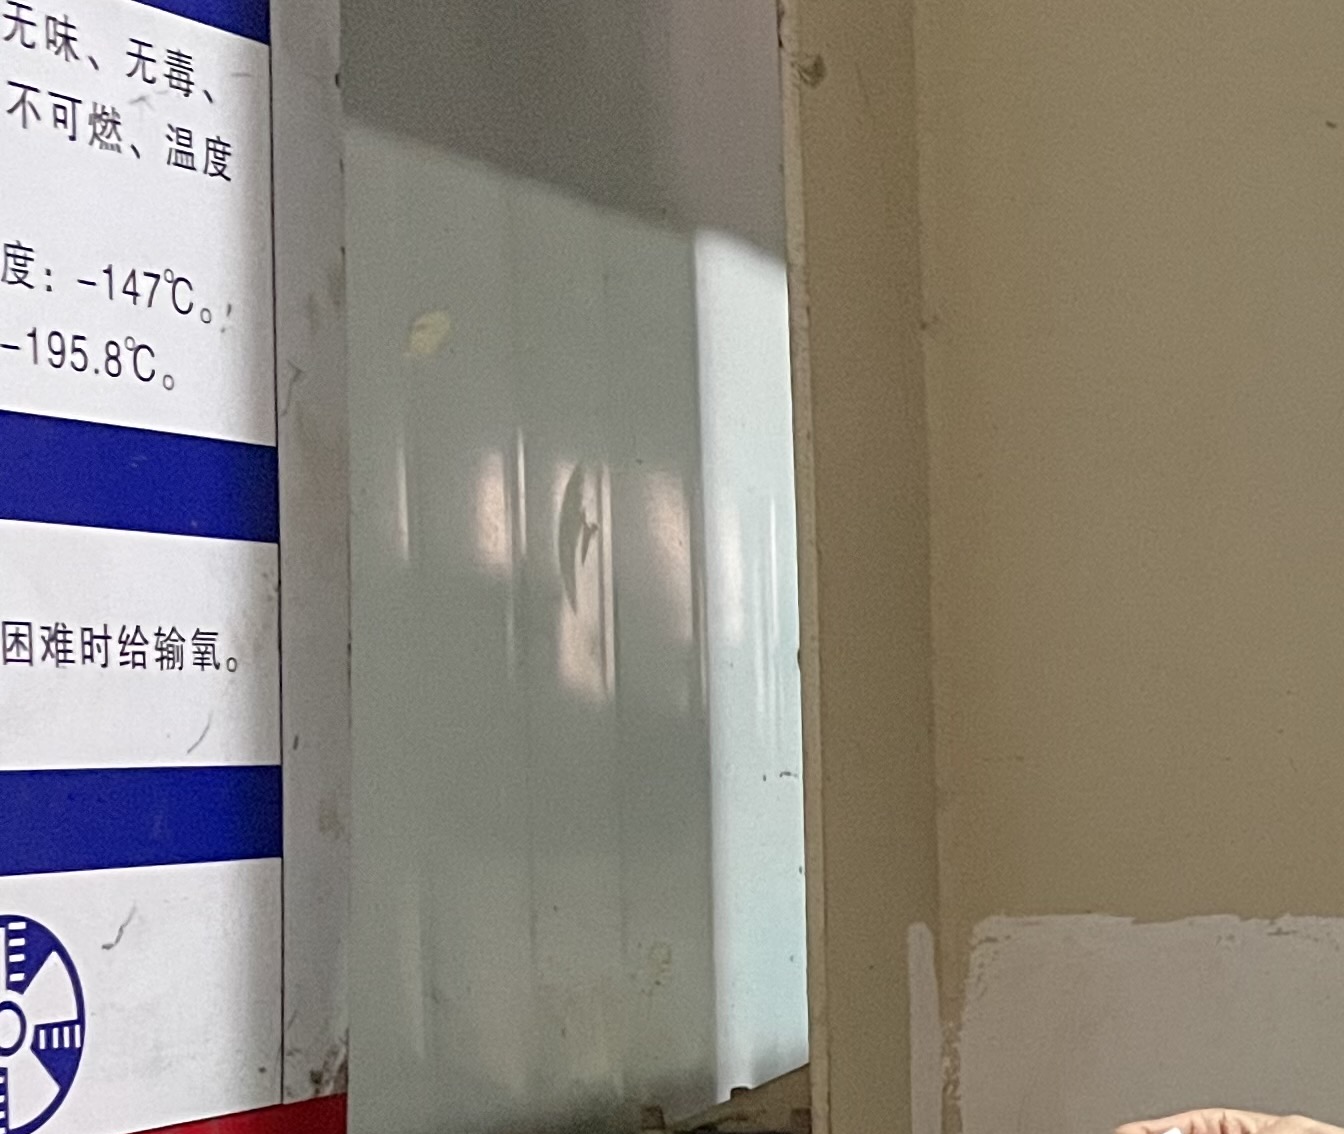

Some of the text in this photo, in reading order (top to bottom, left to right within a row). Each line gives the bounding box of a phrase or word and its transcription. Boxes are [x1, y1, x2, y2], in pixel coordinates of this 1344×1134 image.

[2, 1, 214, 104] 无味、无毒、
[6, 80, 233, 183] 不可燃、温度
[2, 620, 238, 674] 困难时给输氧。
